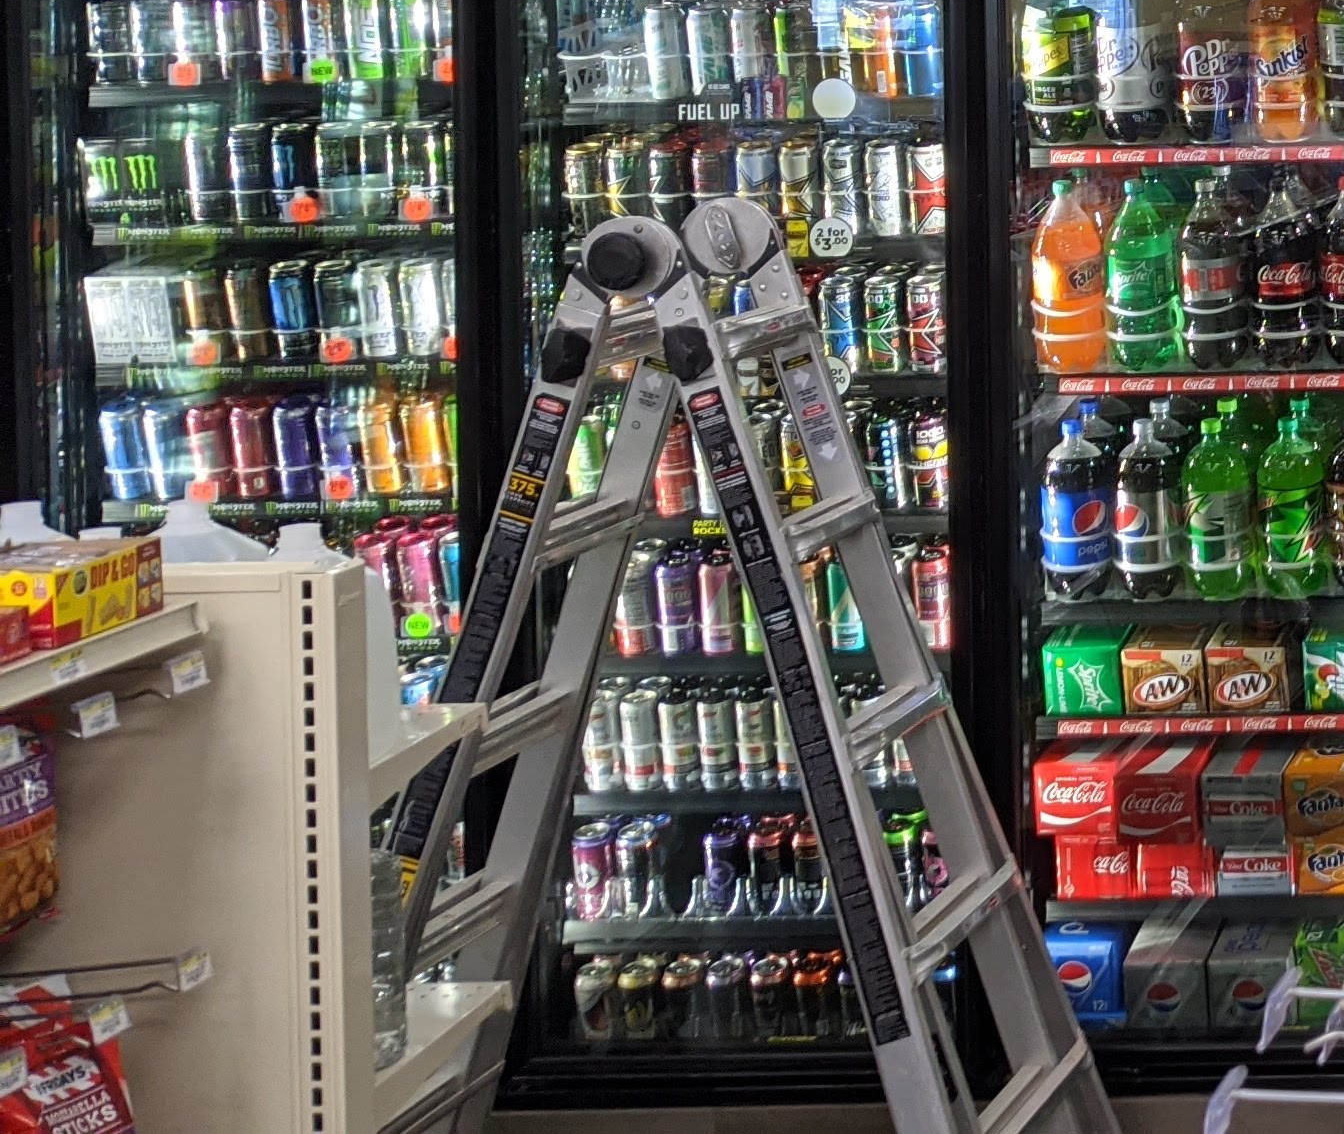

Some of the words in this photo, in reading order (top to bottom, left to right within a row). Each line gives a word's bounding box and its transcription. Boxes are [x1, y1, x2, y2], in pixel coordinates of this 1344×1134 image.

[1256, 34, 1308, 77] Sunkist
[311, 66, 333, 76] NEW
[678, 104, 714, 120] FUEL
[720, 104, 740, 119] UP
[816, 229, 826, 238] 2
[827, 227, 846, 239] for
[509, 477, 537, 495] 375
[693, 520, 716, 528] PARTY
[407, 621, 430, 630] NEW
[1180, 653, 1193, 665] 12
[1263, 650, 1276, 662] 12
[1077, 665, 1100, 708] Sprite
[1042, 781, 1107, 804] Coca-Cola
[1121, 791, 1185, 814] Coca-Cola
[1230, 801, 1268, 817] Coke
[1243, 858, 1282, 872] Coke
